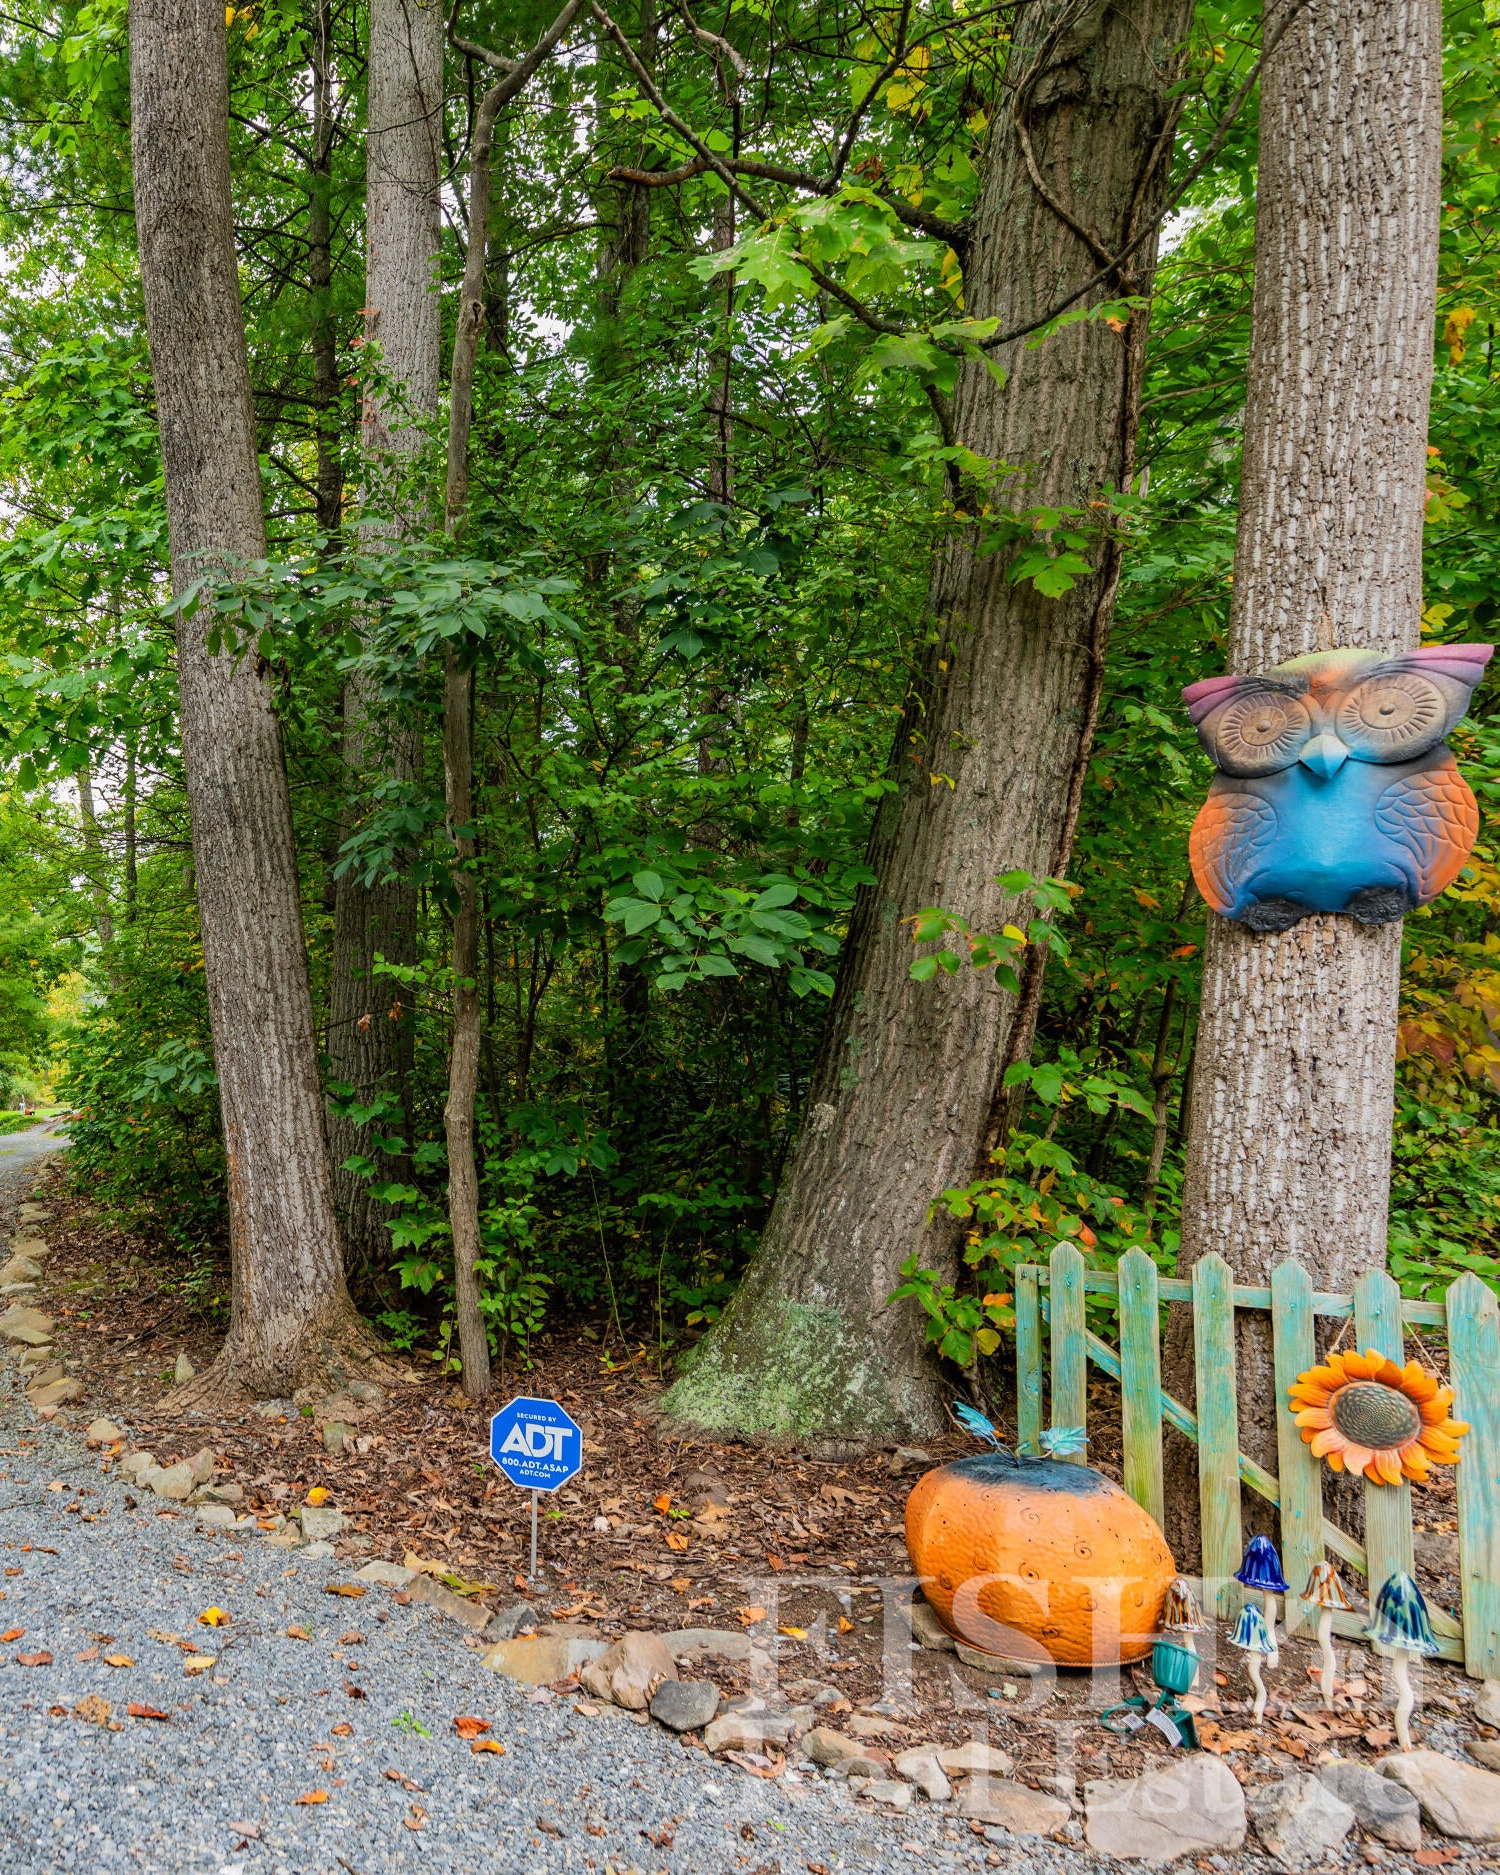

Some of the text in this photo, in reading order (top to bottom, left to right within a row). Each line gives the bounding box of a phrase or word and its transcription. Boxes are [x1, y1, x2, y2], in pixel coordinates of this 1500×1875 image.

[516, 1412, 547, 1422] SECURED
[500, 1422, 573, 1461] ADT
[501, 1457, 569, 1474] 800.ADT.ASAP
[519, 1469, 551, 1479] ADT.COM
